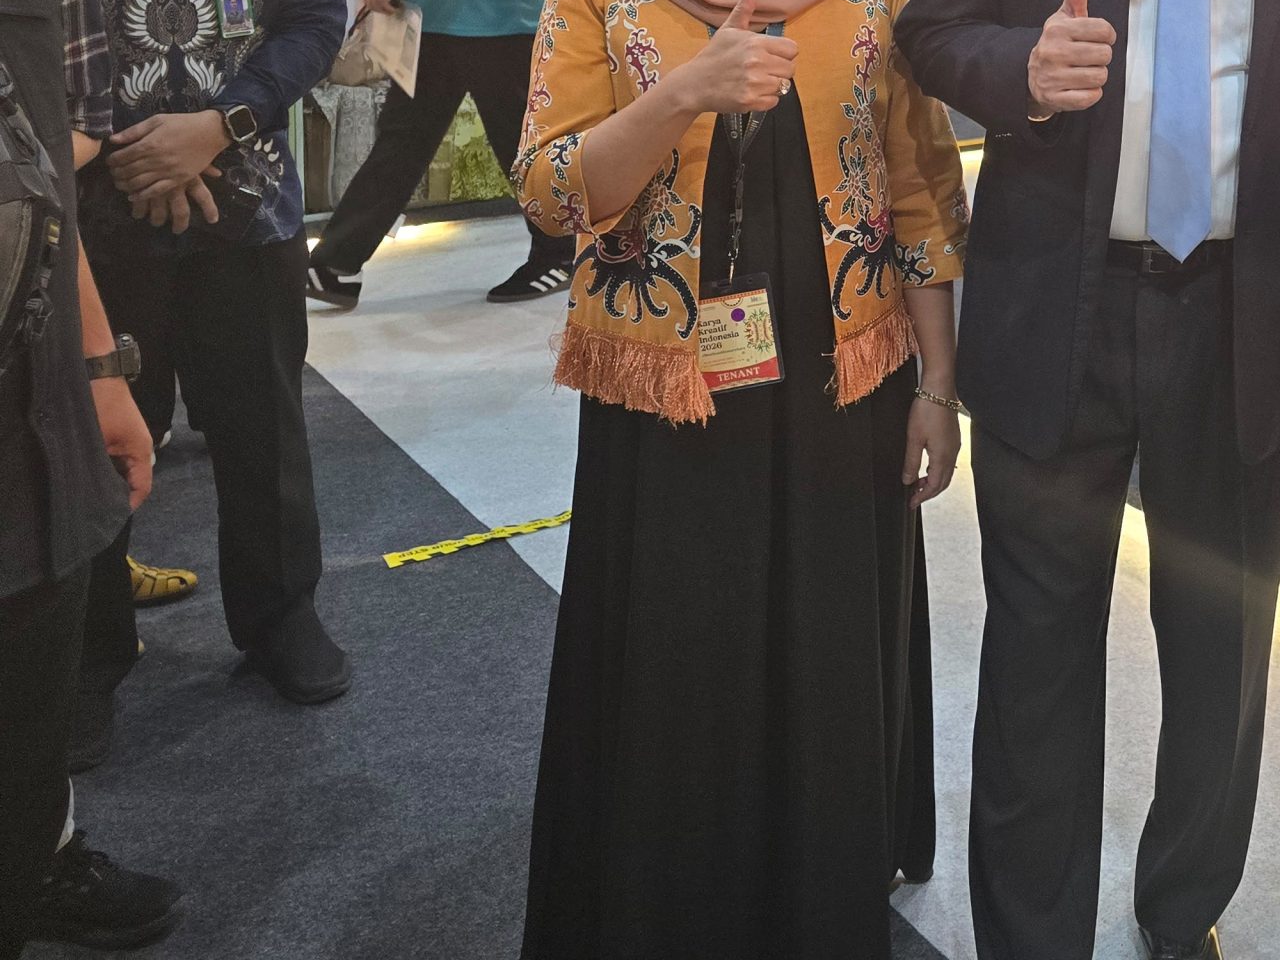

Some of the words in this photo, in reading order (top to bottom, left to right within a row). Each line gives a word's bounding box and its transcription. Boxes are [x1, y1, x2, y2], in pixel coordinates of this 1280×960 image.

[698, 324, 727, 336] Kreatif
[699, 330, 740, 344] Indonesia
[700, 341, 723, 351] 2026
[716, 366, 761, 382] TENANT
